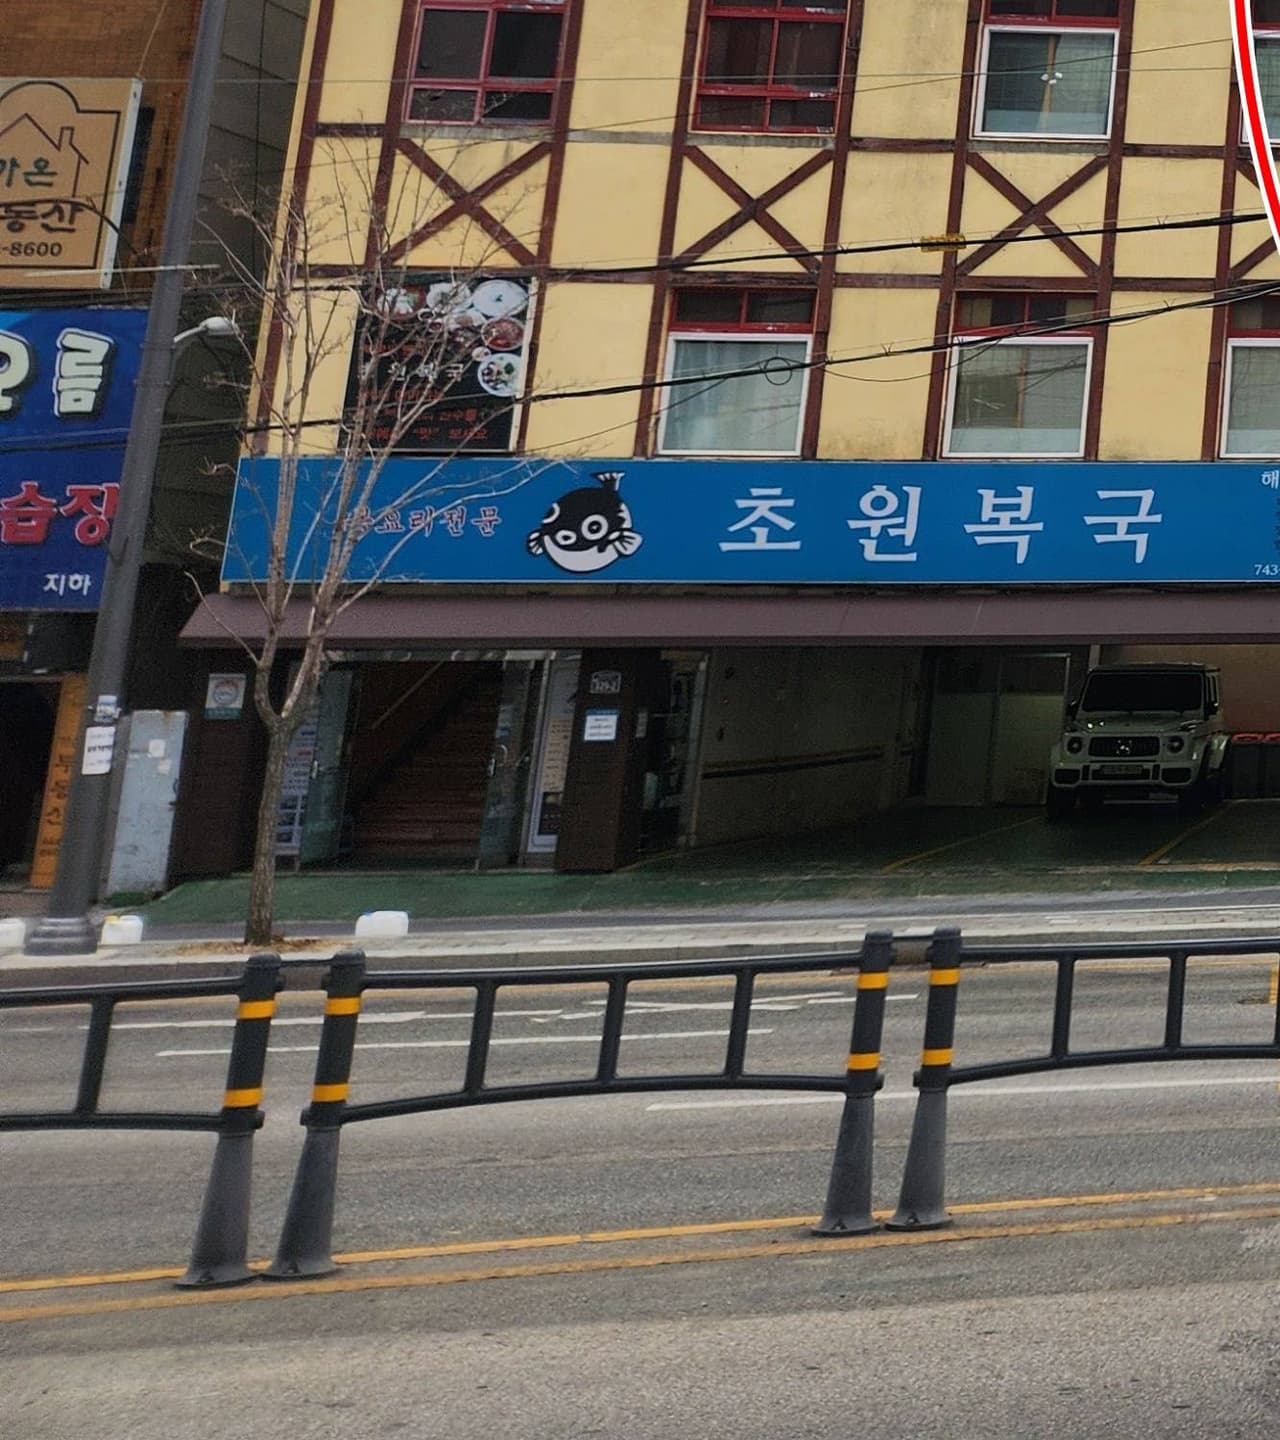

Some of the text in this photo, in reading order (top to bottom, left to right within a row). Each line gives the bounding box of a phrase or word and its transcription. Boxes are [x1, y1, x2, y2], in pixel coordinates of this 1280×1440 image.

[0, 200, 84, 233] 동산
[718, 485, 1163, 564] 초원복국
[43, 573, 92, 596] 지하
